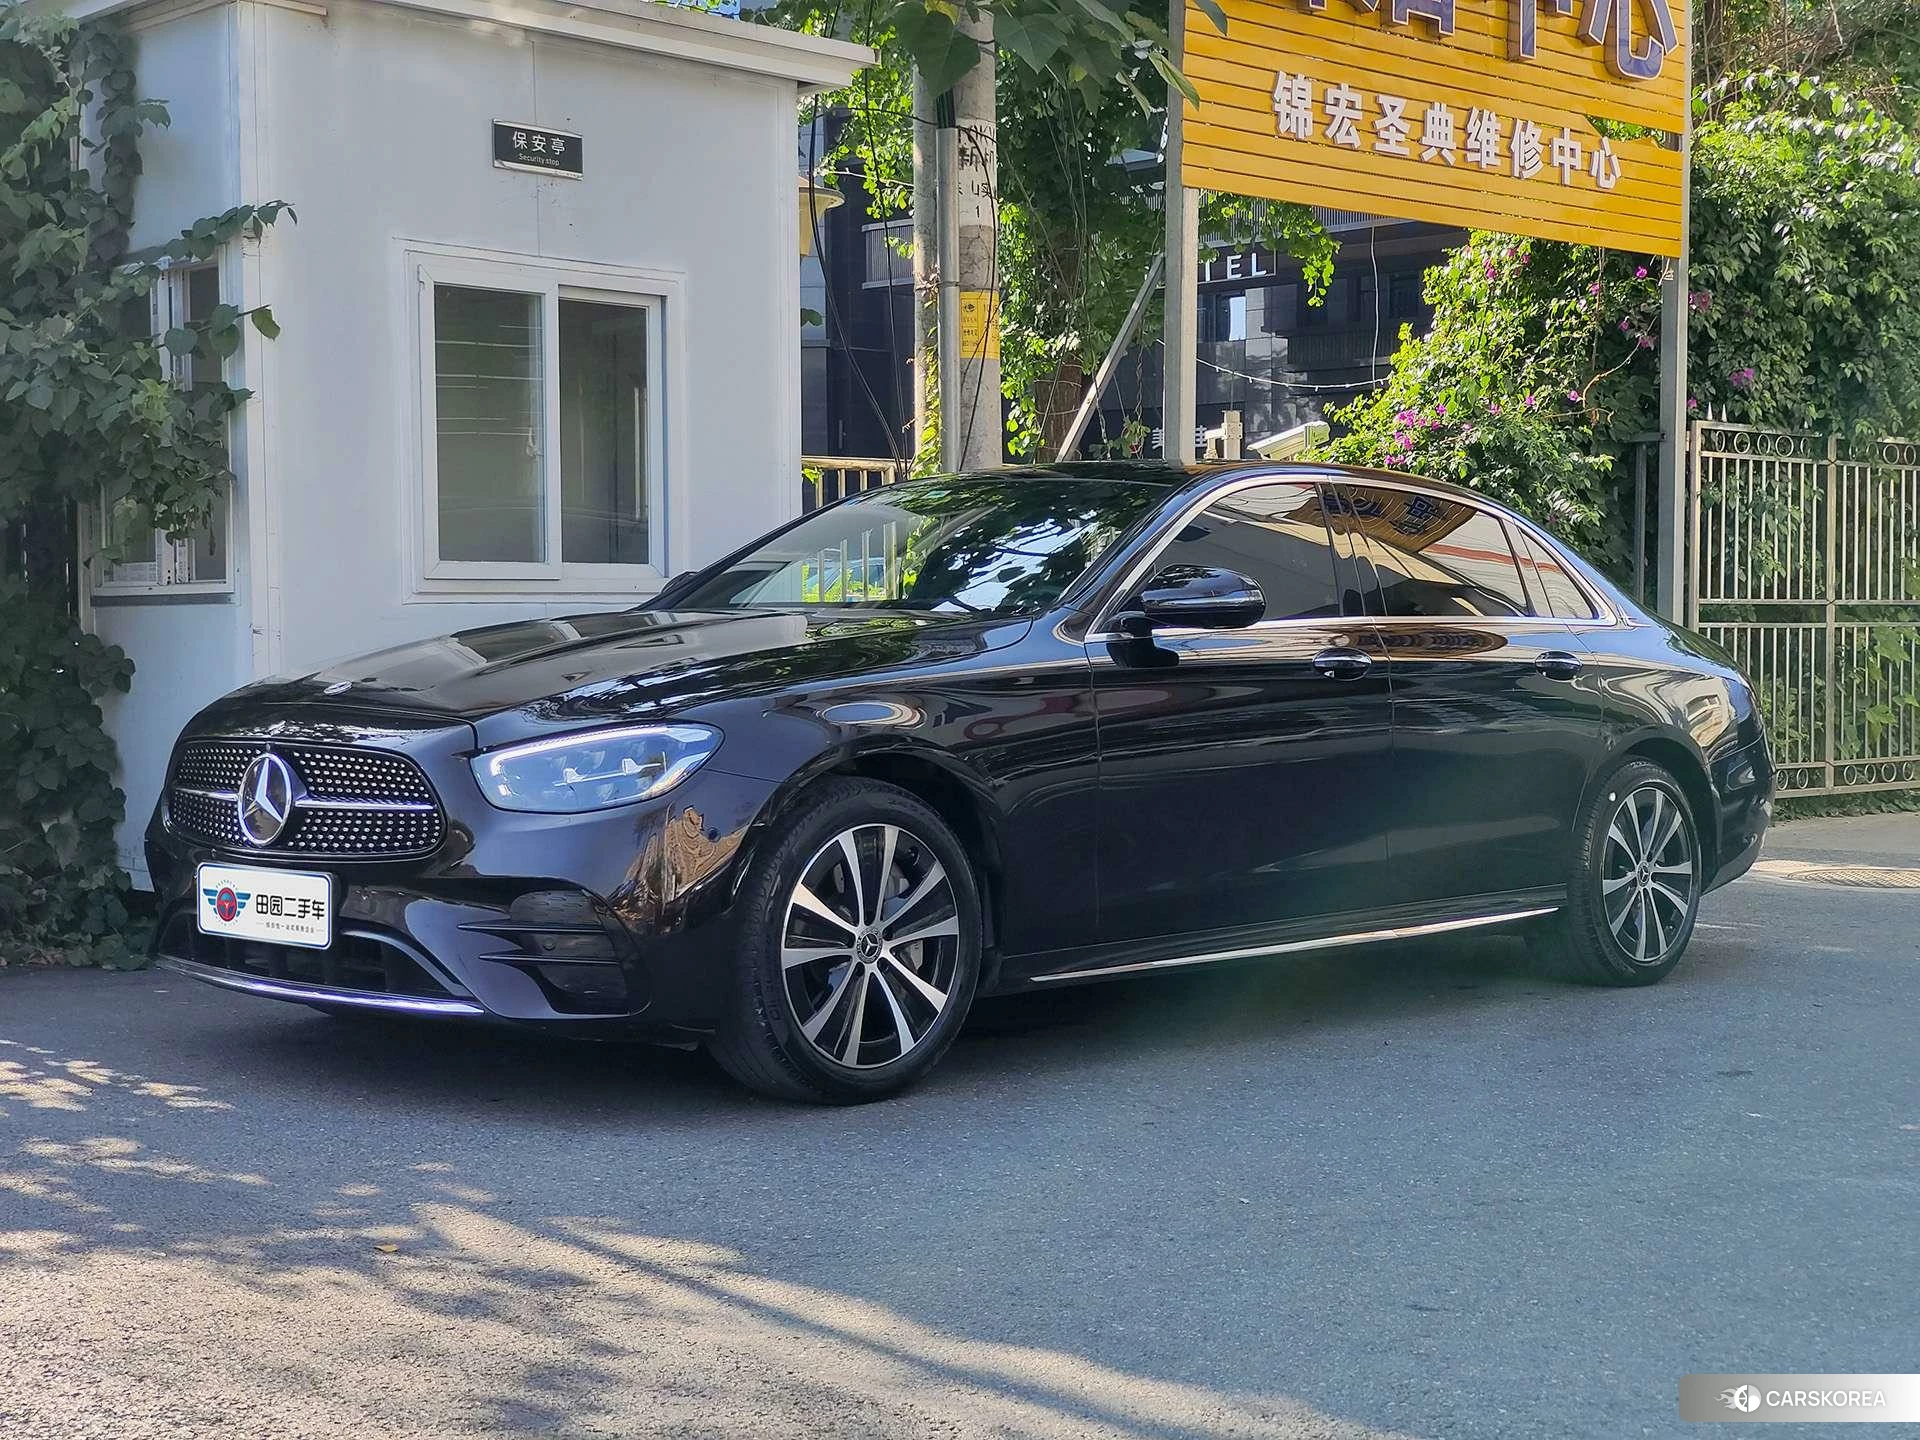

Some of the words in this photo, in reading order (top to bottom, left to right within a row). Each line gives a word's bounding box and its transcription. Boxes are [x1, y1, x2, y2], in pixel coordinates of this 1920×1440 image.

[512, 130, 566, 155] 保安亭
[1272, 70, 1623, 190] 锦宏圣典维修中心
[519, 153, 545, 165] Security
[255, 894, 325, 920] 田园二手车
